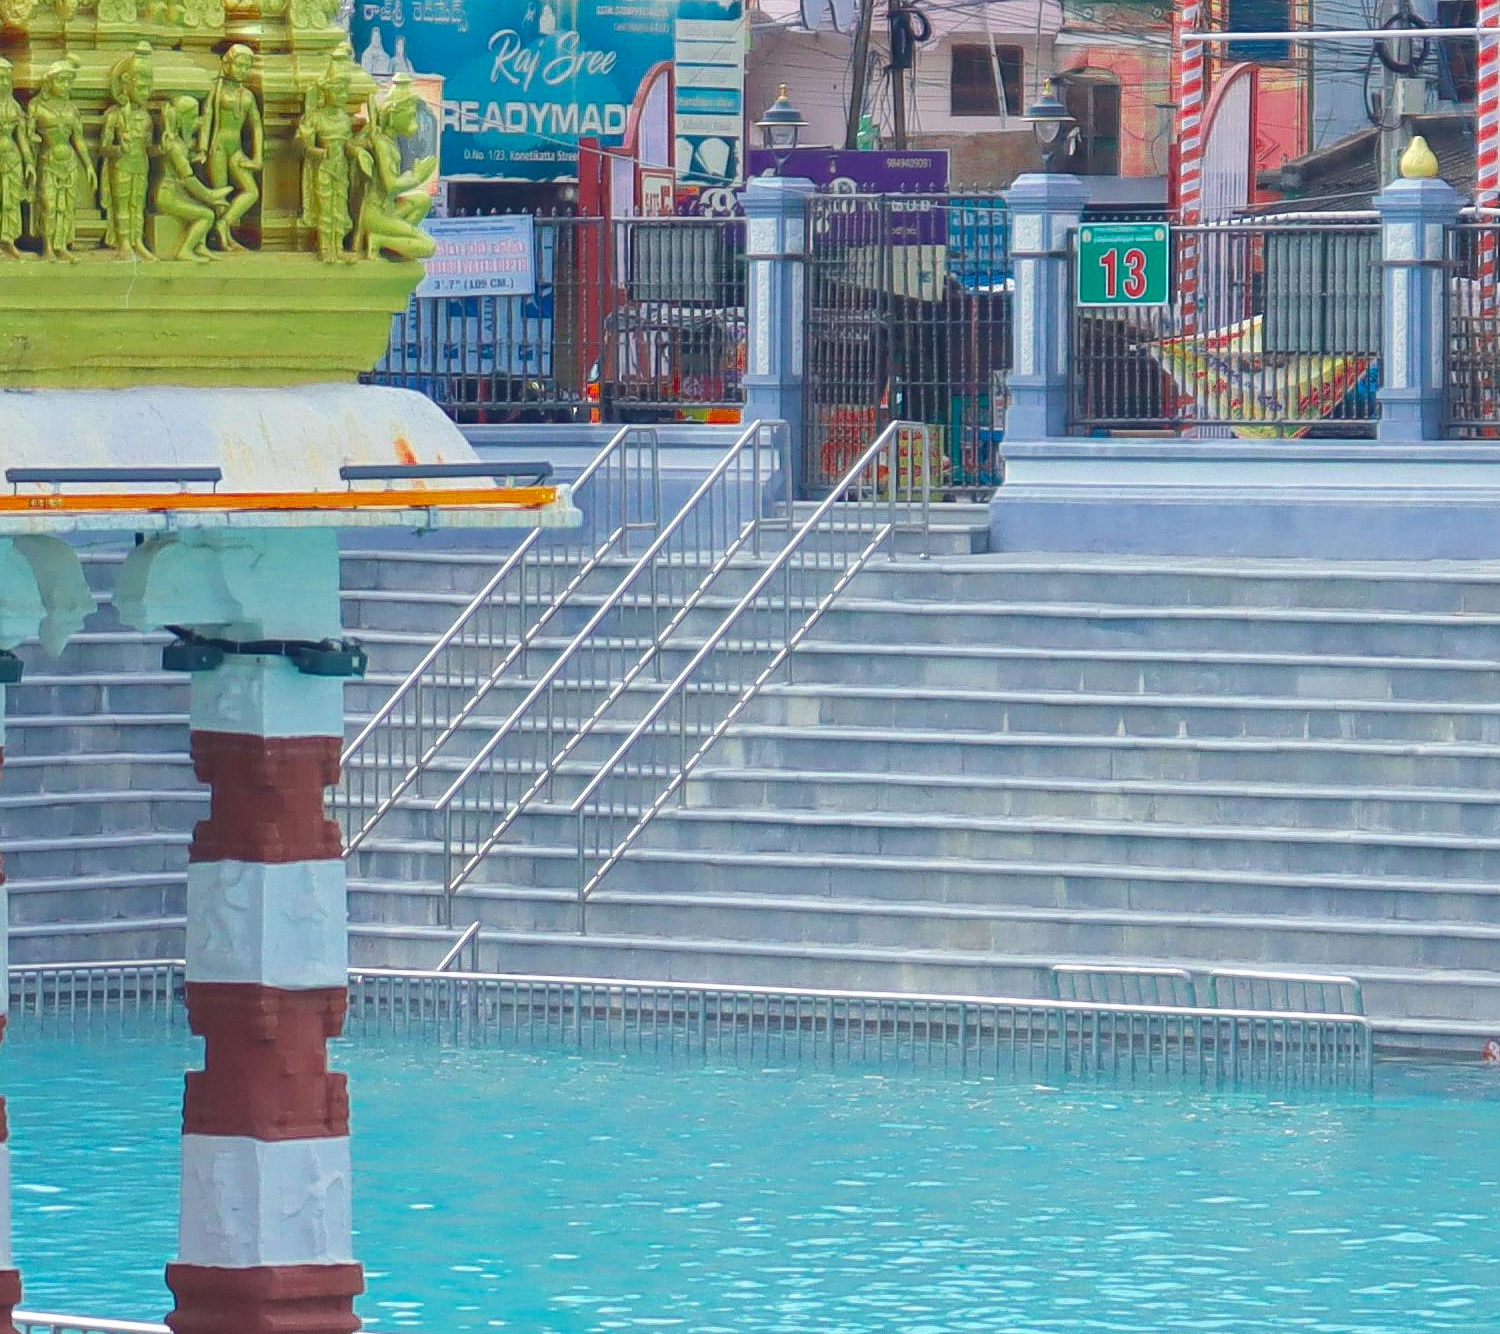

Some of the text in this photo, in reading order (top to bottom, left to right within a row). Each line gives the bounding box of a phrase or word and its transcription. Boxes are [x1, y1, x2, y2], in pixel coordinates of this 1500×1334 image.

[488, 29, 617, 92] Raj Sree
[1099, 247, 1147, 299] 13
